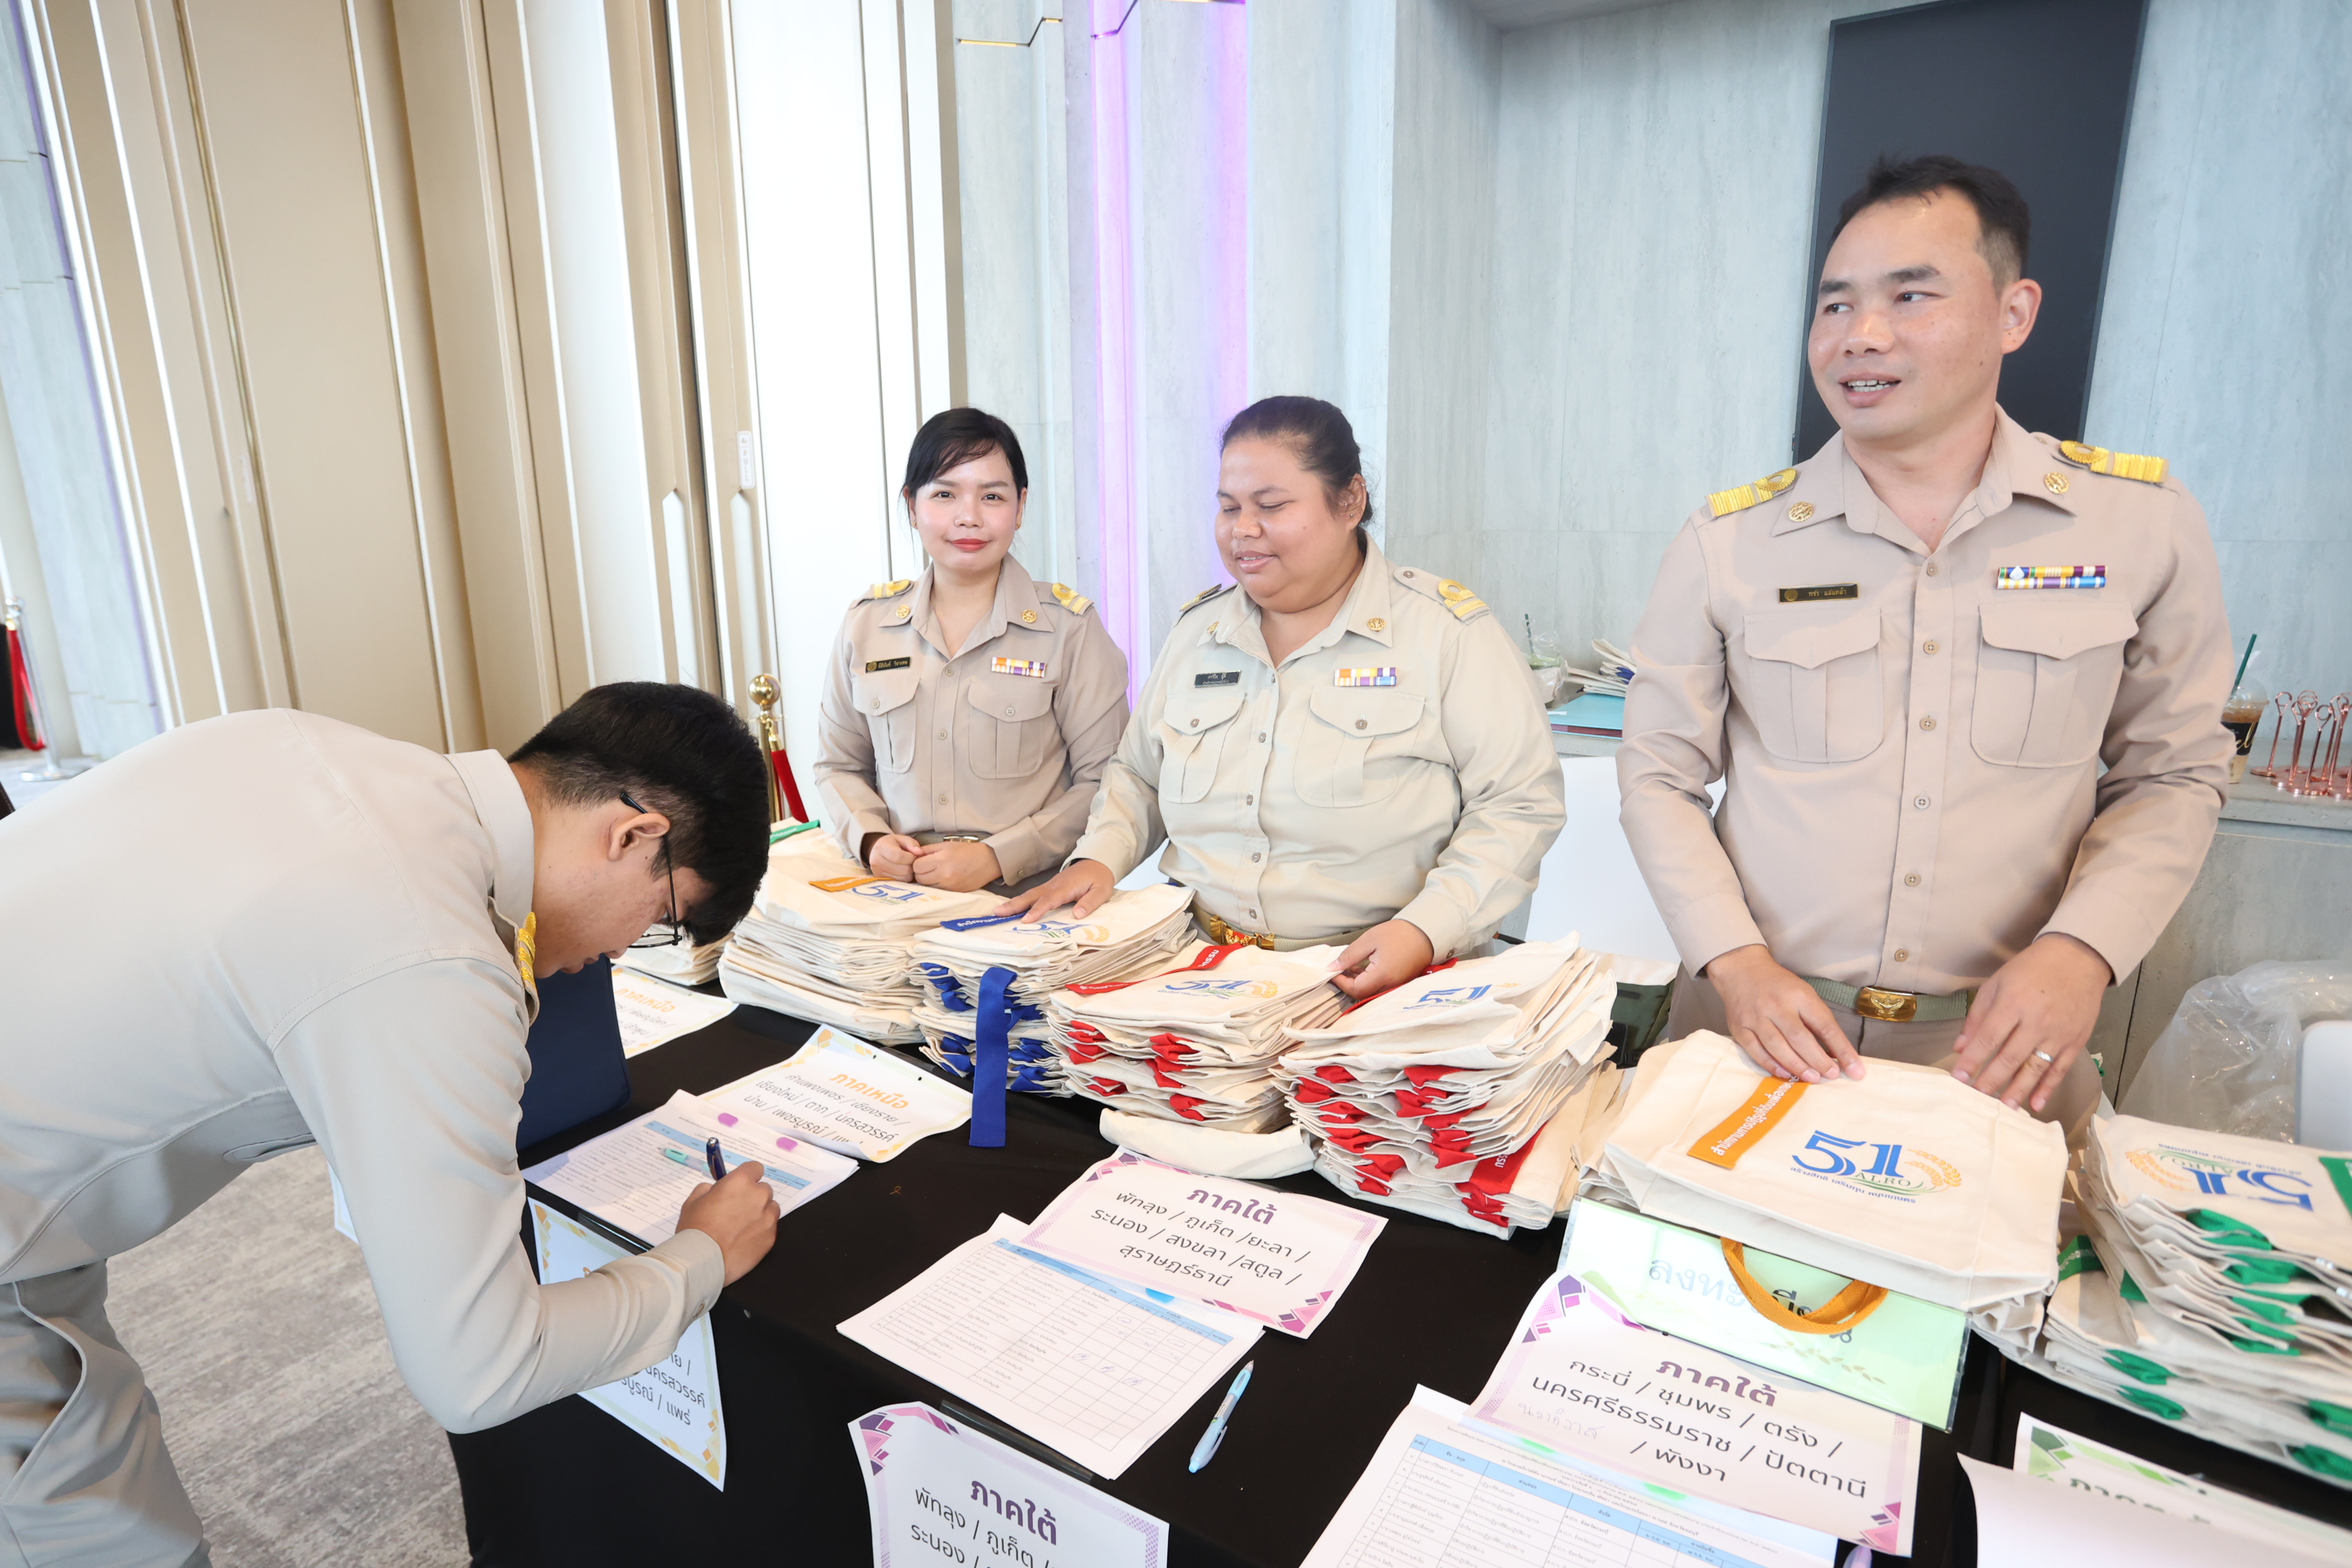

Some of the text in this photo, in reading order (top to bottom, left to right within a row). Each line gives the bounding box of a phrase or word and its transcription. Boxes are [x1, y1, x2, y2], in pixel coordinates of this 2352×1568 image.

[852, 884, 926, 901] 51
[614, 988, 676, 1012] ภาคเหนือ
[756, 1080, 803, 1102] เชียงใหม่
[805, 1101, 829, 1114] ตาก
[786, 1075, 846, 1101] กำแพงเพชร
[850, 1101, 899, 1123] เชียงราย
[829, 1073, 909, 1110] ภาคเหนือ
[744, 1095, 767, 1108] น่าน
[772, 1108, 830, 1135] เพชรบูรณ์
[1792, 1130, 1905, 1178] 51
[1854, 1172, 1911, 1187] ALRO
[2182, 1167, 2314, 1212] 51
[1116, 1192, 1167, 1215] พัทลุง
[1185, 1216, 1234, 1238] ภูเก็ต
[1187, 1189, 1277, 1225] ภาคใต้
[1091, 1209, 1148, 1234] ระนอง
[1166, 1233, 1227, 1261] สงขลา
[1119, 1244, 1234, 1287] สุราษฎร์ธานี
[1570, 1361, 1632, 1386] กระบี่
[1658, 1389, 1732, 1419] ชุมพร
[1764, 1422, 1819, 1447] ตรัง
[1656, 1360, 1777, 1407] ภาคใต้
[667, 1401, 691, 1426] แพร่
[1532, 1377, 1732, 1452] นครศรีธรรมราช
[1765, 1449, 1866, 1498] ปัตตานี
[1656, 1448, 1726, 1482] พังงา
[915, 1487, 966, 1529] พัทลุง
[987, 1531, 1034, 1568] ภูเก็ต
[971, 1480, 1057, 1545] ภาคใต้
[911, 1525, 965, 1564] ระนอง
